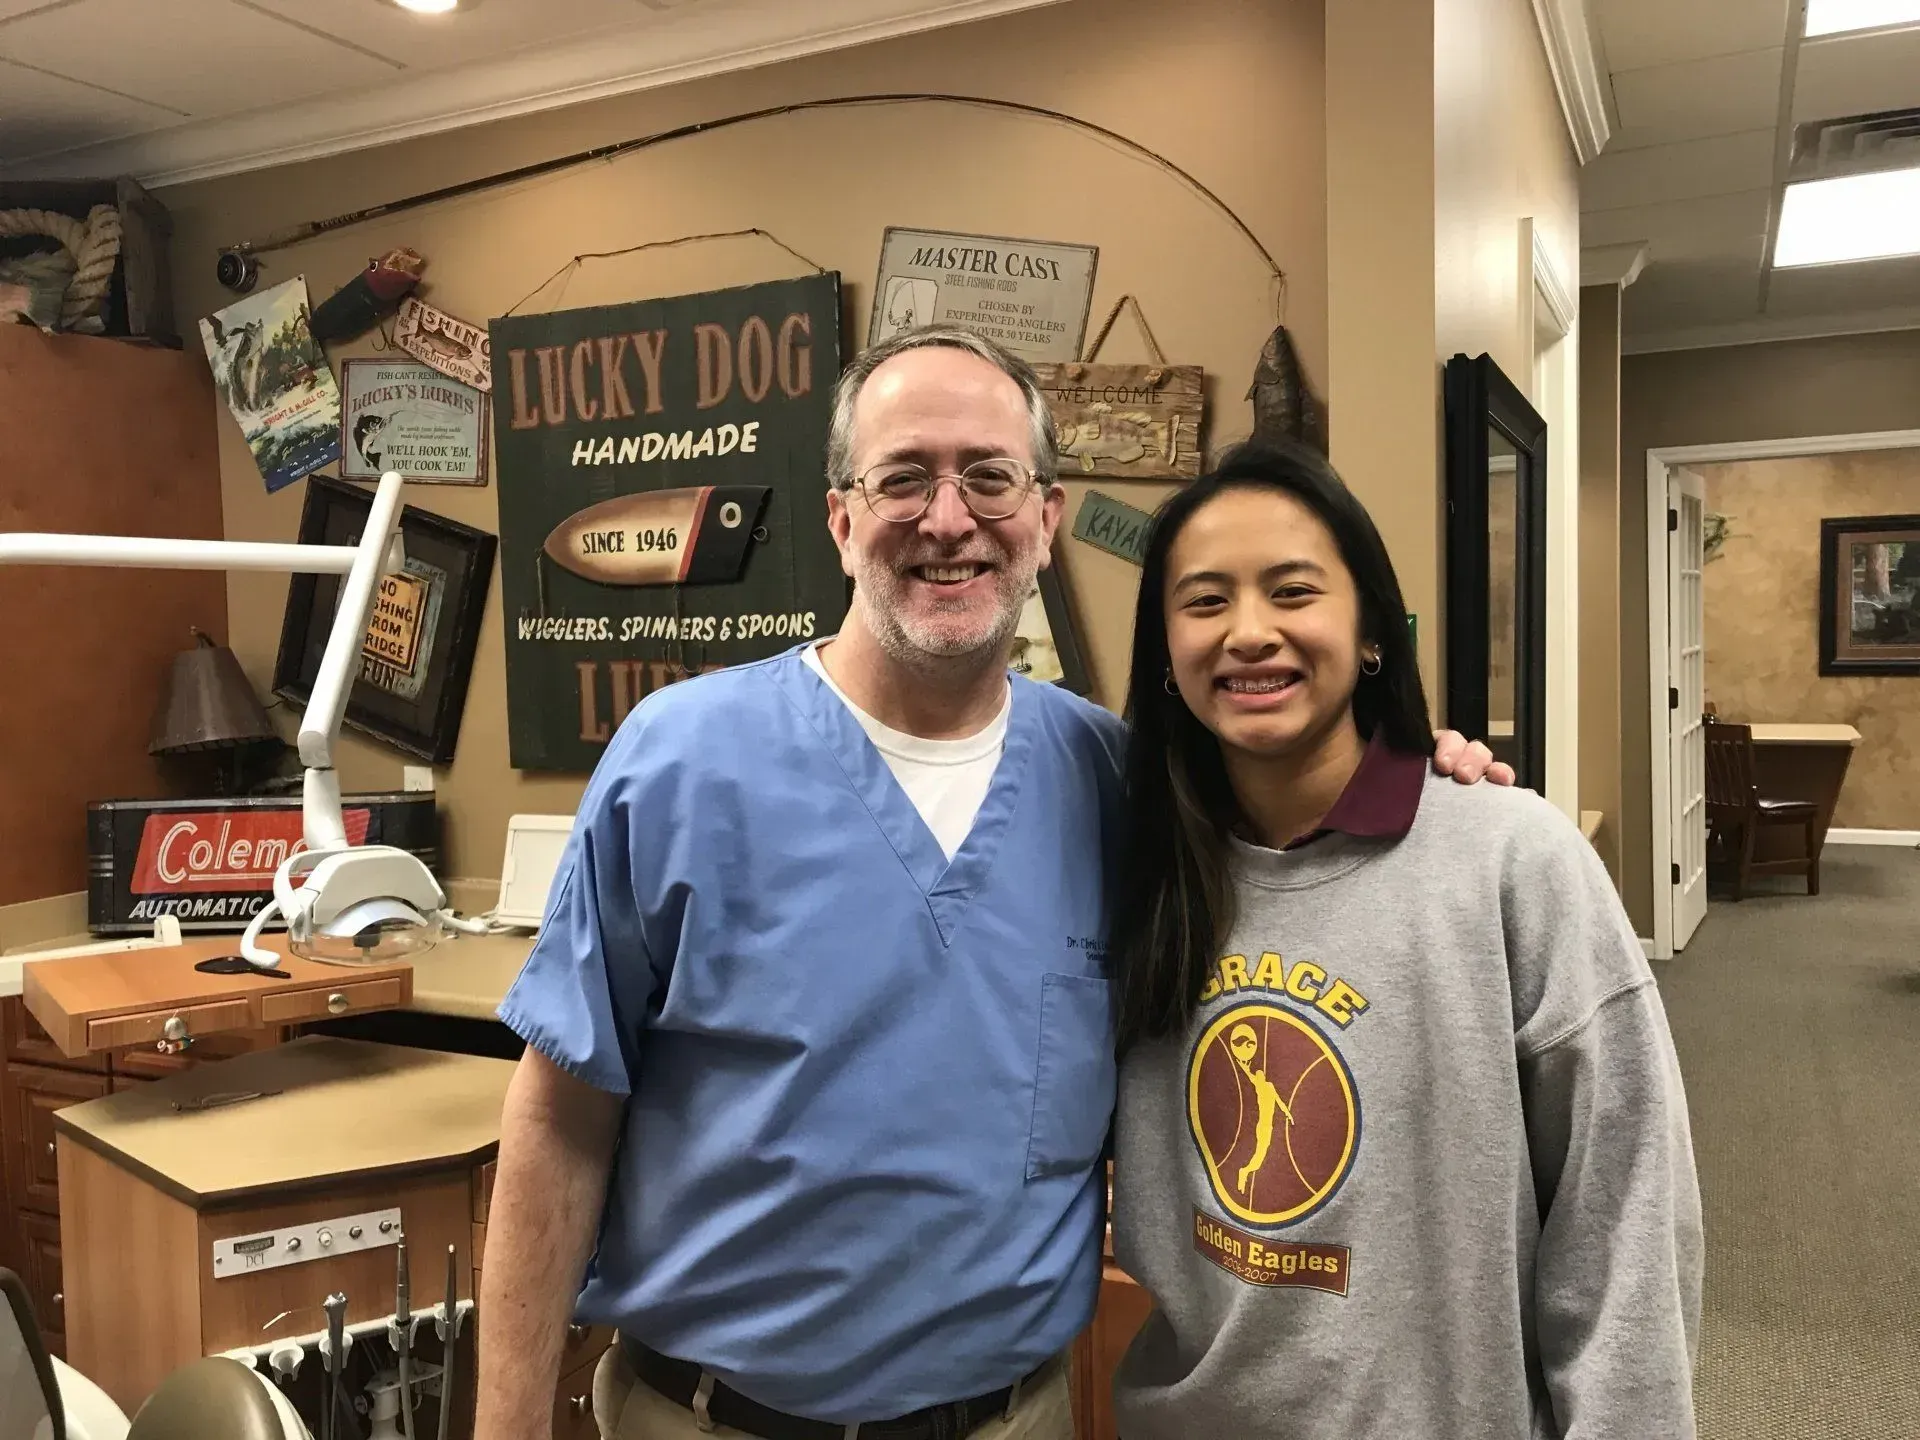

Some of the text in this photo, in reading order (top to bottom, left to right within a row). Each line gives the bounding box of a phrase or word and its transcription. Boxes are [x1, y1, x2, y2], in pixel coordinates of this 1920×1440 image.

[908, 247, 1062, 281] MASTER CAST
[944, 273, 1018, 292] STEEL FISHING RODS
[978, 300, 1035, 315] CHOSEN BY
[945, 309, 1066, 332] EXPERIENCED ANGLERS
[977, 326, 1004, 338] OVER
[1006, 329, 1016, 339] 50
[1018, 331, 1051, 344] YEARS
[409, 341, 472, 379] EXPEDITIONS
[507, 312, 813, 431] LUCKY DOG
[377, 371, 393, 380] FISH
[352, 383, 417, 413] LUCKY'S
[1055, 385, 1164, 405] WELCOME
[387, 444, 416, 456] WE'LL
[418, 445, 448, 457] HOOK
[571, 421, 760, 466] HANDMADE
[391, 459, 411, 470] YOU
[414, 460, 442, 471] COOK
[582, 527, 678, 555] SINCE 1946
[371, 616, 402, 638] ROM
[517, 616, 614, 642] WIGGLERS,
[719, 616, 732, 641] &
[736, 611, 817, 640] SPOONS
[365, 632, 406, 659] RIDGE
[157, 820, 309, 885] Colem
[129, 896, 264, 920] AUTOMATIC
[1066, 935, 1079, 948] Dr.
[1196, 1214, 1339, 1275] Golden Eagles
